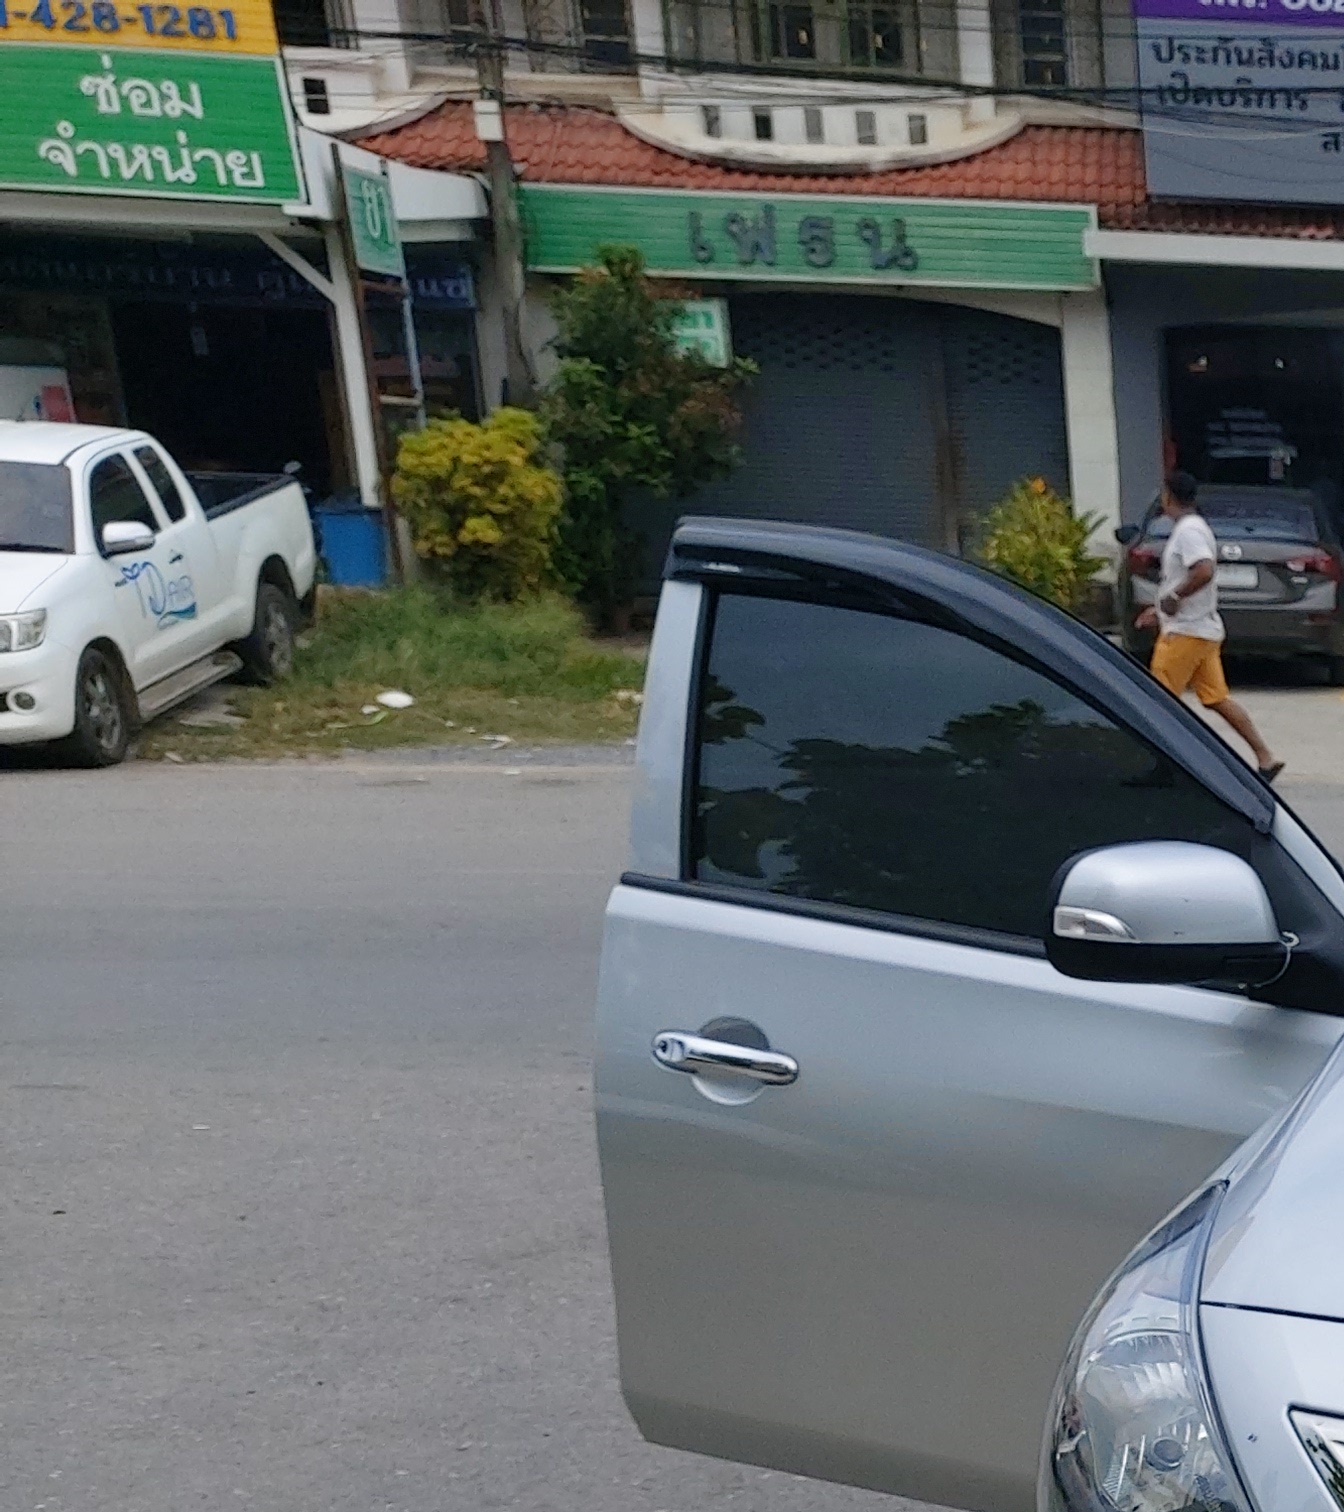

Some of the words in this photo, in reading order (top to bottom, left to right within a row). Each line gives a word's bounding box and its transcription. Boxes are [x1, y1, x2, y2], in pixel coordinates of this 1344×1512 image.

[80, 54, 204, 119] ซ่อม
[39, 120, 265, 188] จำหน่าย
